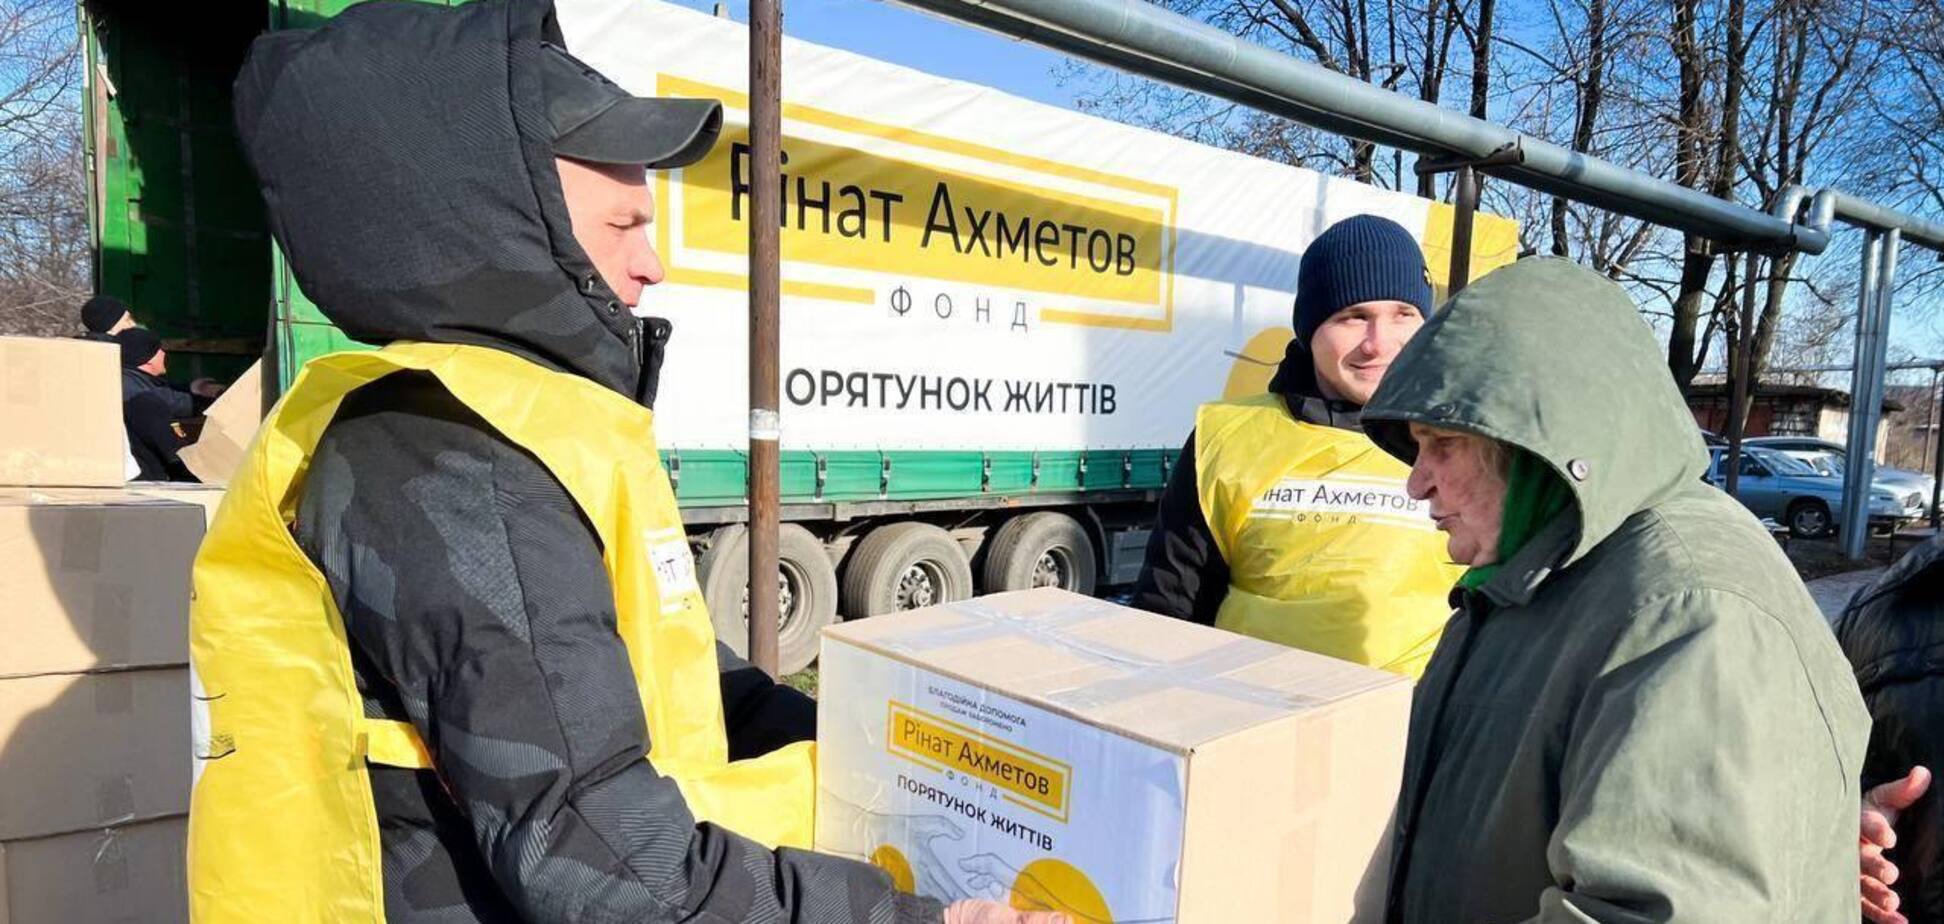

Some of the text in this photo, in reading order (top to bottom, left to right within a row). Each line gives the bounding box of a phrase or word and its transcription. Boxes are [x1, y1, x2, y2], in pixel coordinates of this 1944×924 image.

[920, 181, 1137, 276] Ахметов
[890, 282, 1029, 333] ФОНД
[785, 368, 1117, 415] ОРЯТУНОК ЖИТТІВ
[1312, 484, 1419, 512] Ахметов
[979, 704, 1026, 727] ДОПОМОГА
[904, 719, 1050, 796] Рінат Ахметов
[898, 774, 1053, 852] ПОРЯТУНОК ЖИТТІВ
